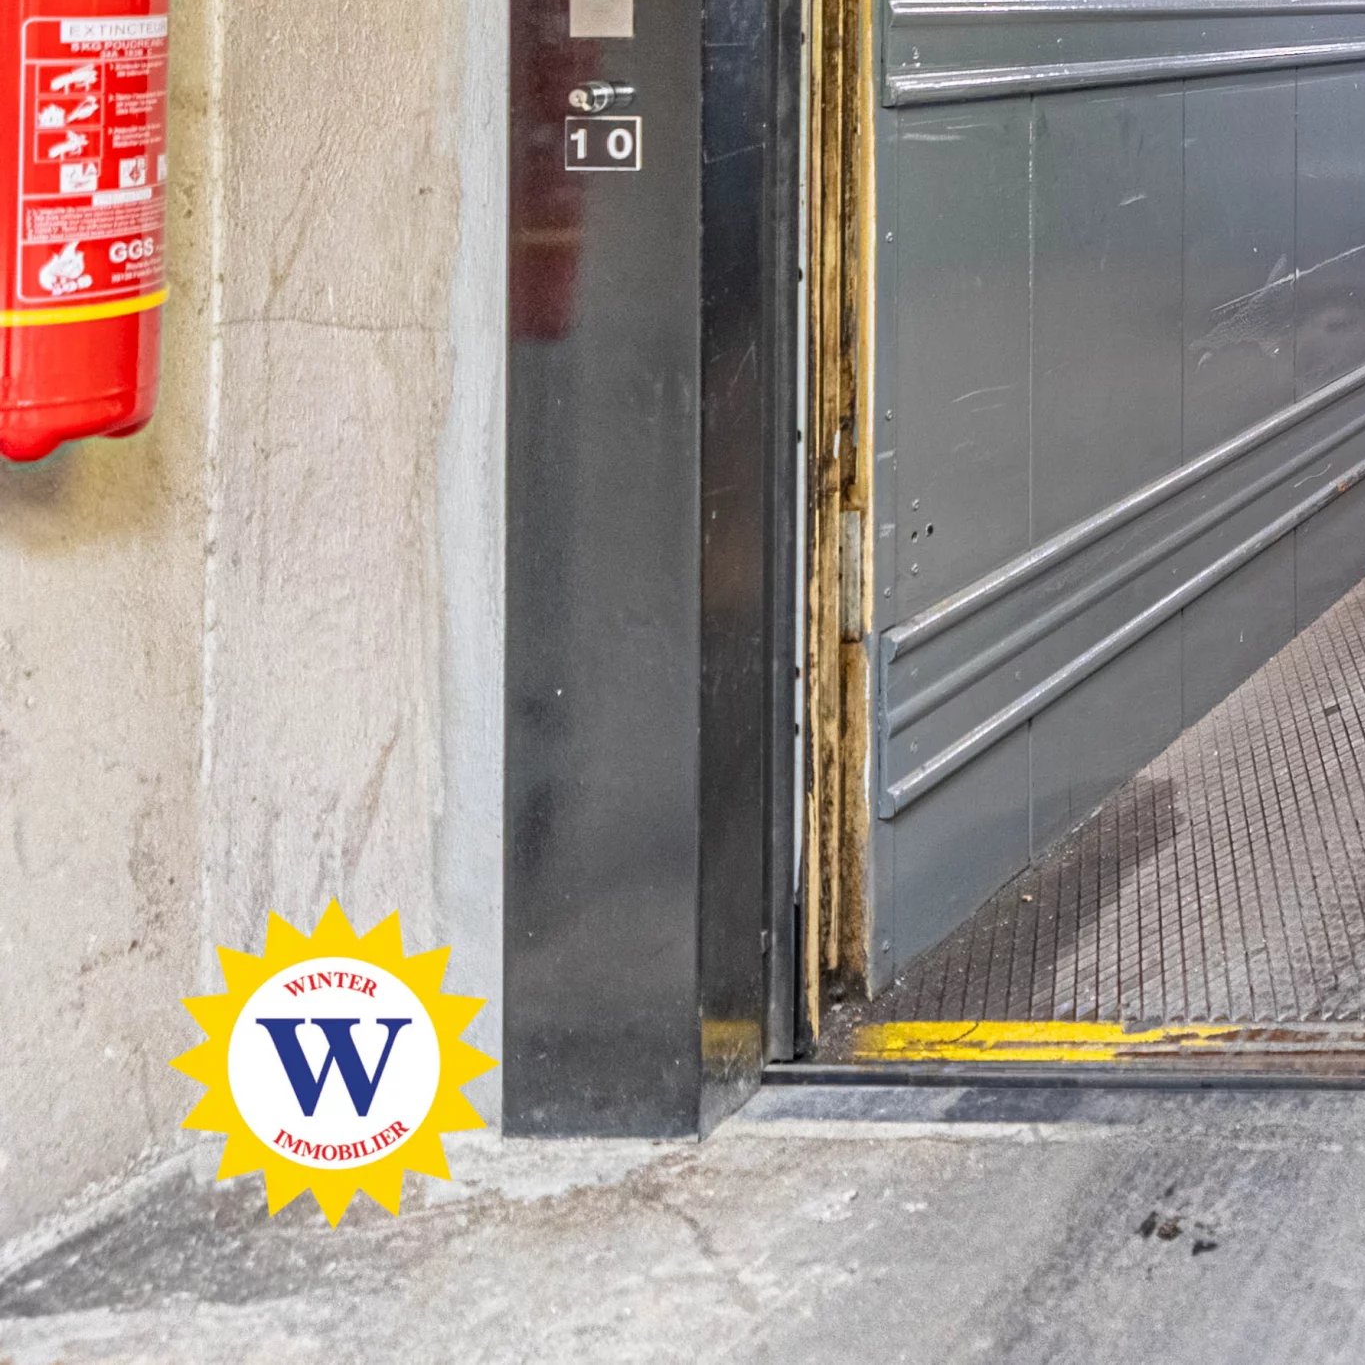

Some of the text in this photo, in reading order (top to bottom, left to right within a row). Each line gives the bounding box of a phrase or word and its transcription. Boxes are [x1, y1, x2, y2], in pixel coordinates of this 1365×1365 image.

[81, 42, 102, 52] KG
[570, 128, 587, 159] 1
[109, 237, 154, 263] GGS
